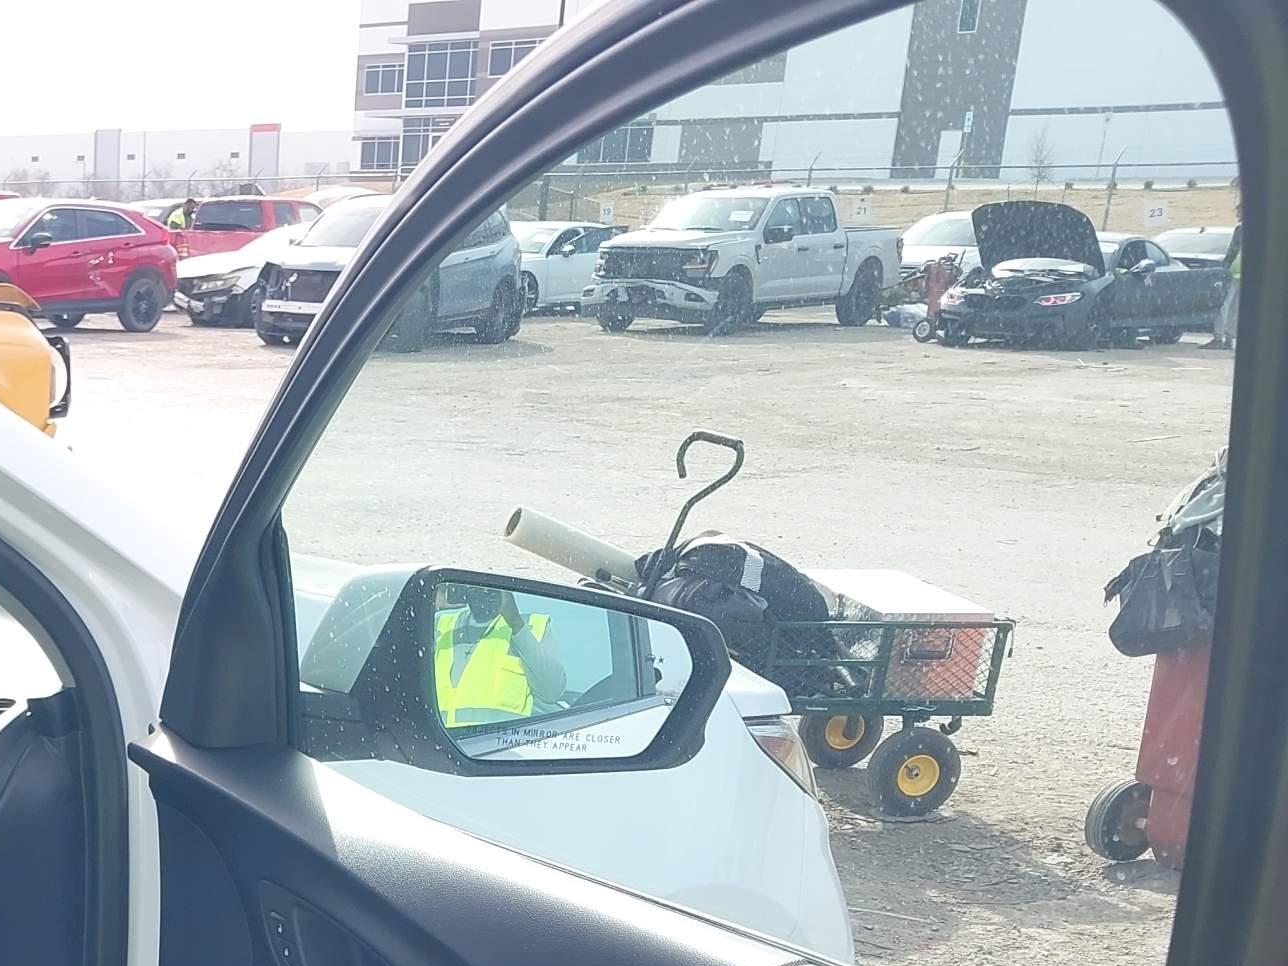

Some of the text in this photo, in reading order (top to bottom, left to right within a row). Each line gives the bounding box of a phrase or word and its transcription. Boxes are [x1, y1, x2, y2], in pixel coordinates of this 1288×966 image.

[602, 207, 612, 216] 19
[855, 206, 867, 216] 21
[1148, 207, 1164, 218] 23
[511, 727, 520, 737] IN
[523, 728, 558, 739] MIRROR
[562, 732, 581, 742] ARE
[585, 734, 621, 745] CLOSER
[496, 737, 588, 753] THAN THEY APPEAR
